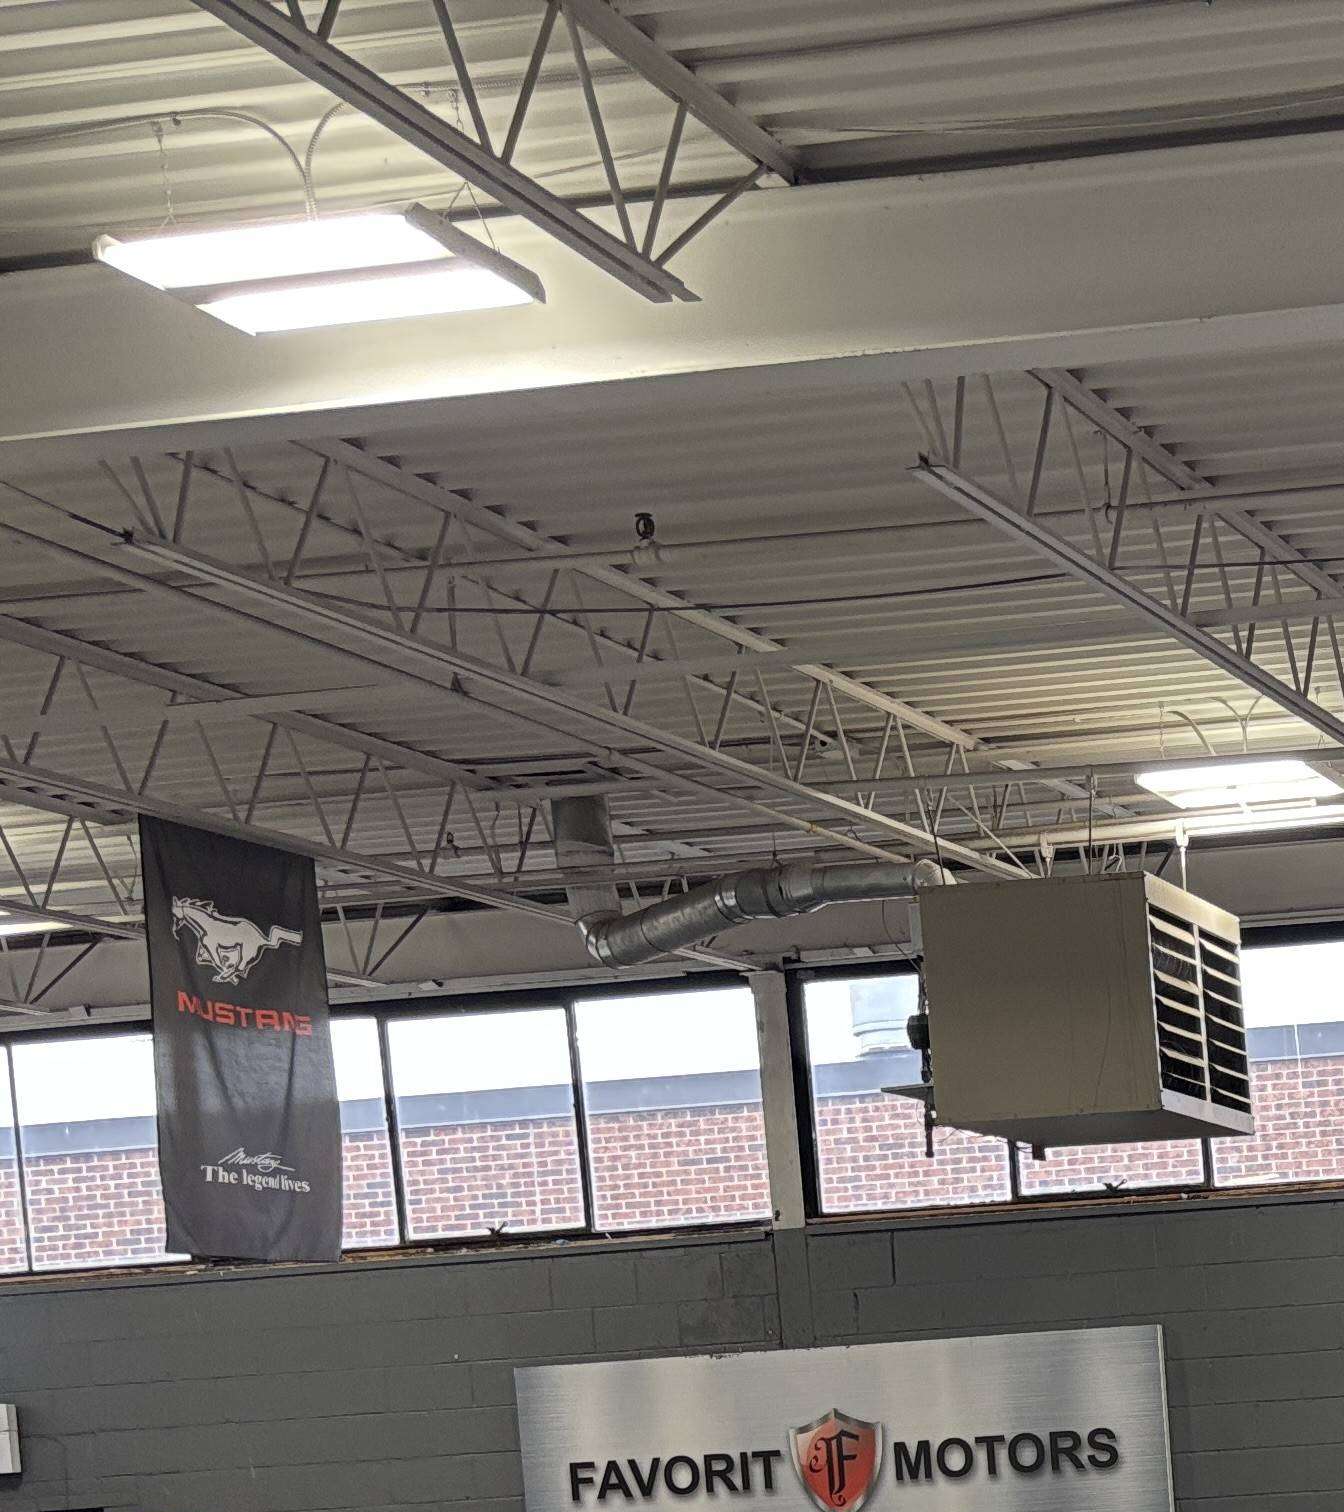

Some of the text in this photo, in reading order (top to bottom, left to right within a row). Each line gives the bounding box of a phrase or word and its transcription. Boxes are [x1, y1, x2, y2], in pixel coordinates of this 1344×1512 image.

[177, 991, 313, 1036] MUSTANG
[201, 1165, 311, 1193] The legend lives
[568, 1427, 1120, 1501] FAVORIT MOTORS
